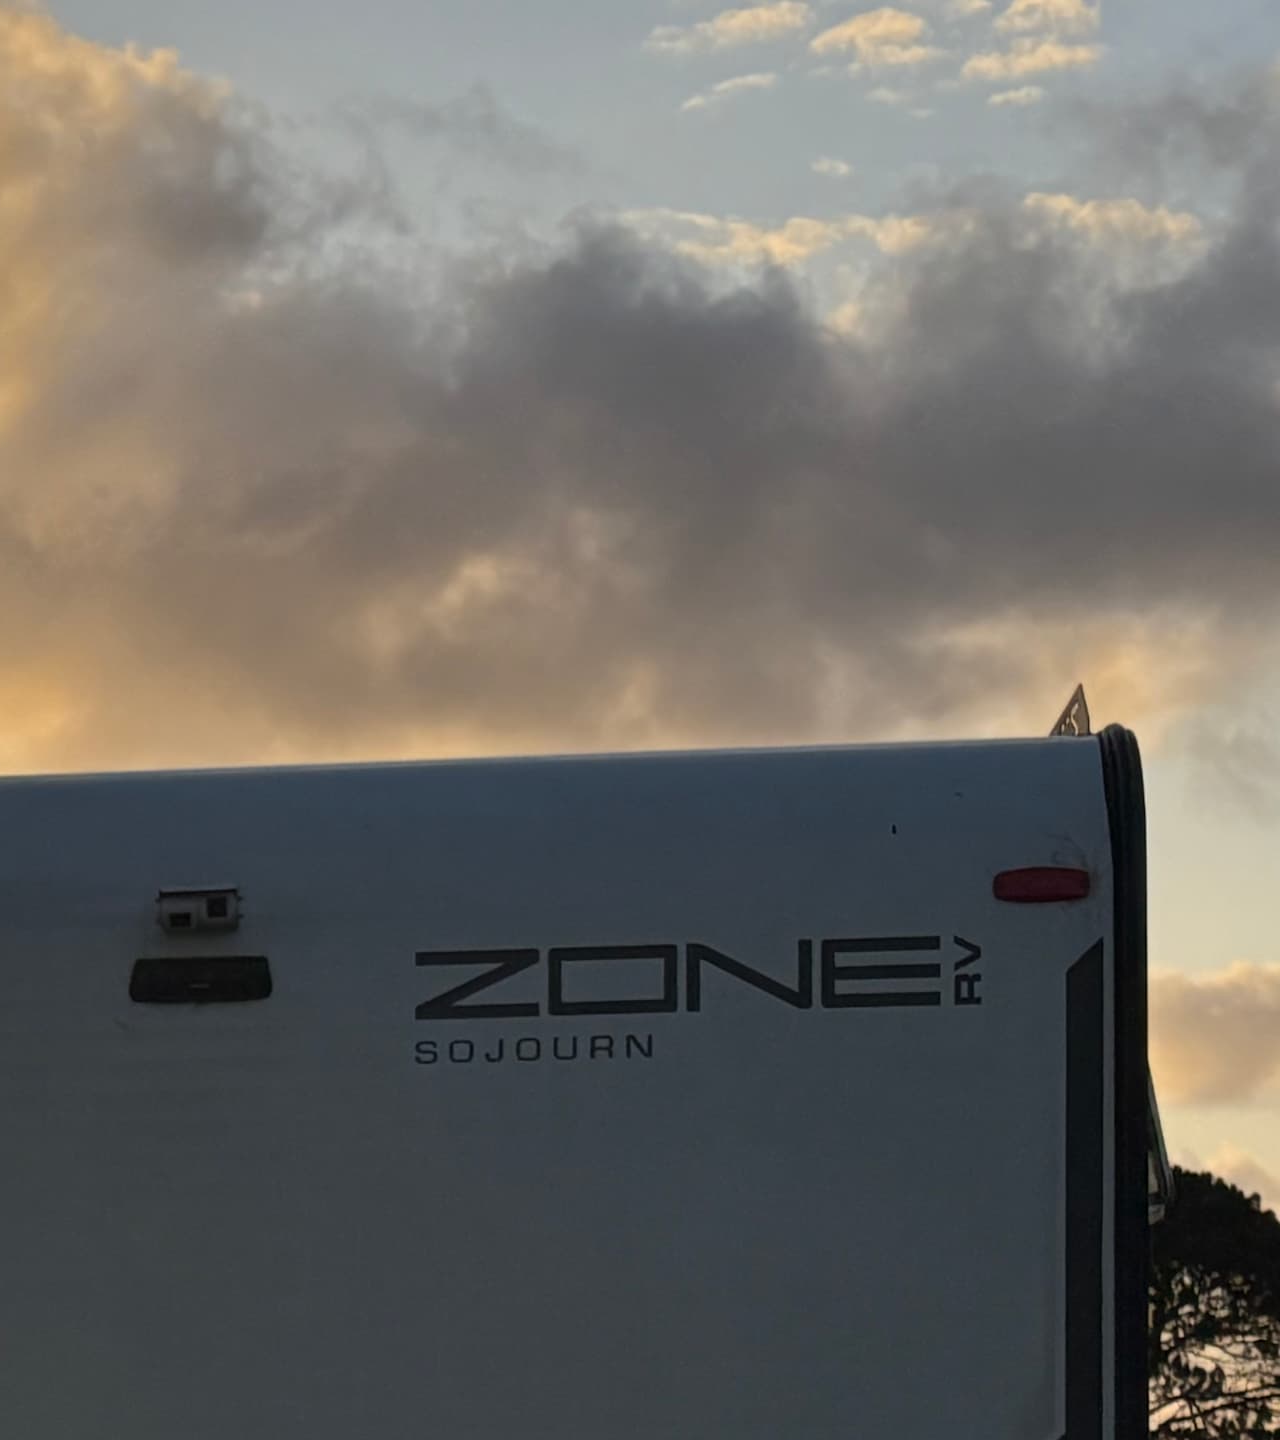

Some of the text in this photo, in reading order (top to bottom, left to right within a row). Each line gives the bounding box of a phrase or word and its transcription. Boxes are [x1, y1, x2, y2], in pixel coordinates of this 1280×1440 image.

[415, 935, 941, 1020] ZONE
[954, 935, 982, 1006] RV
[415, 1033, 654, 1064] SOJOURN
